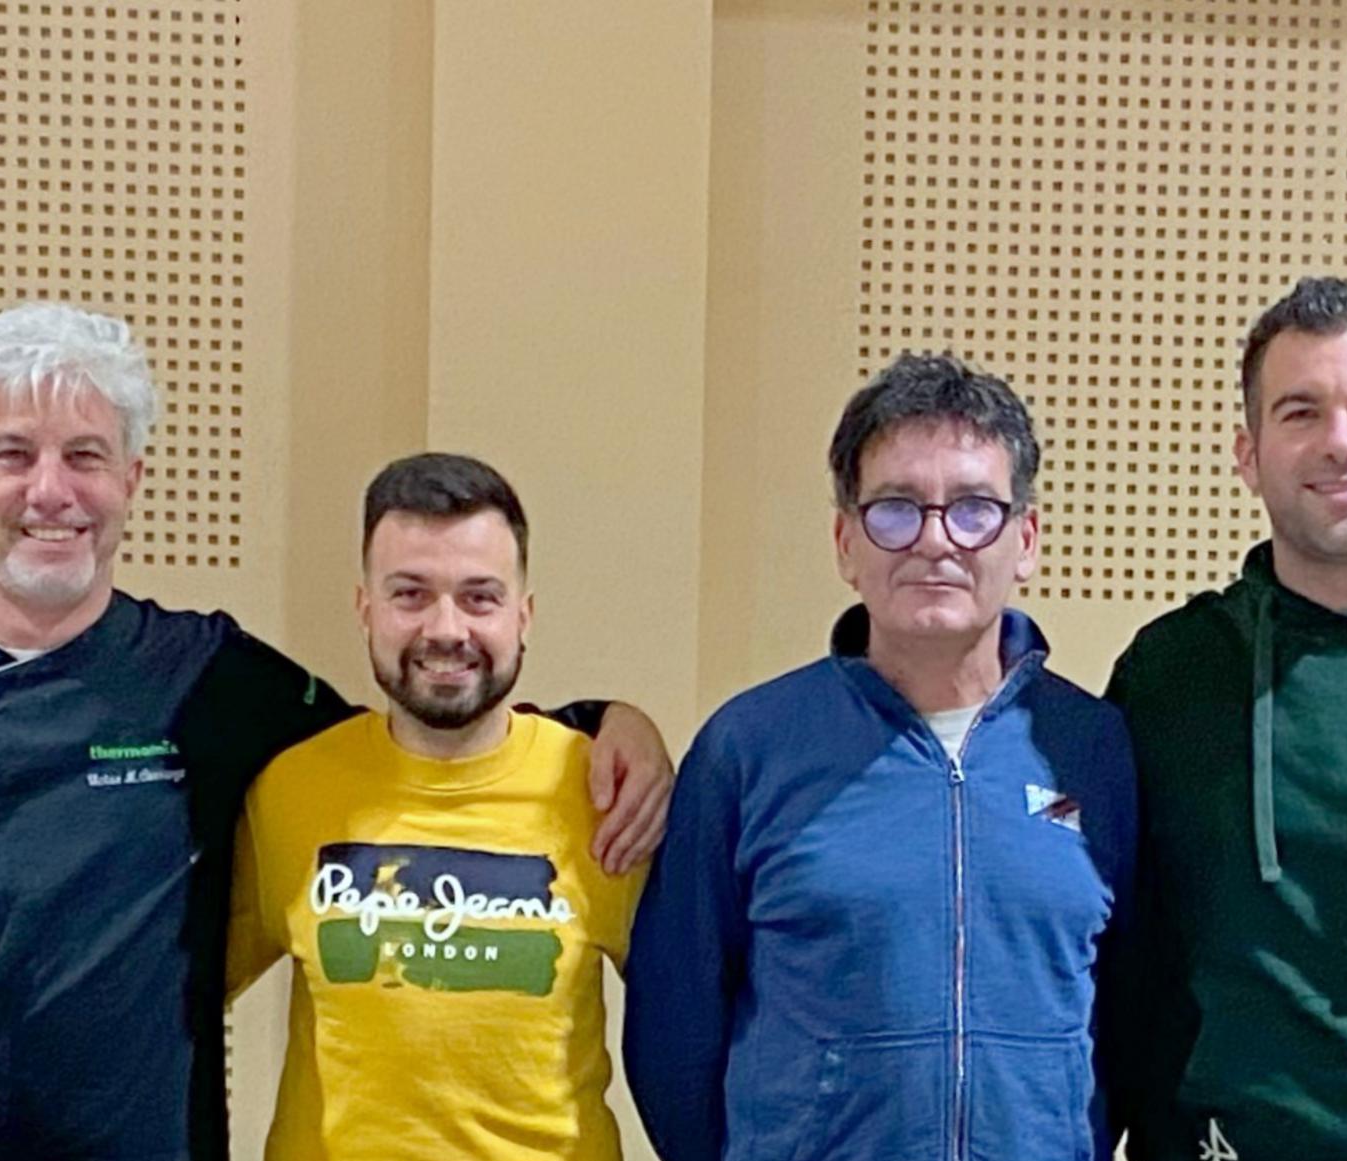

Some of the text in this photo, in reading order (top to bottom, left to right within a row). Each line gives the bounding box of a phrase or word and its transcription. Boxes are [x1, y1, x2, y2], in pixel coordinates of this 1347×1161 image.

[310, 863, 578, 942] Pepe Jeans
[384, 942, 499, 961] LONDON
